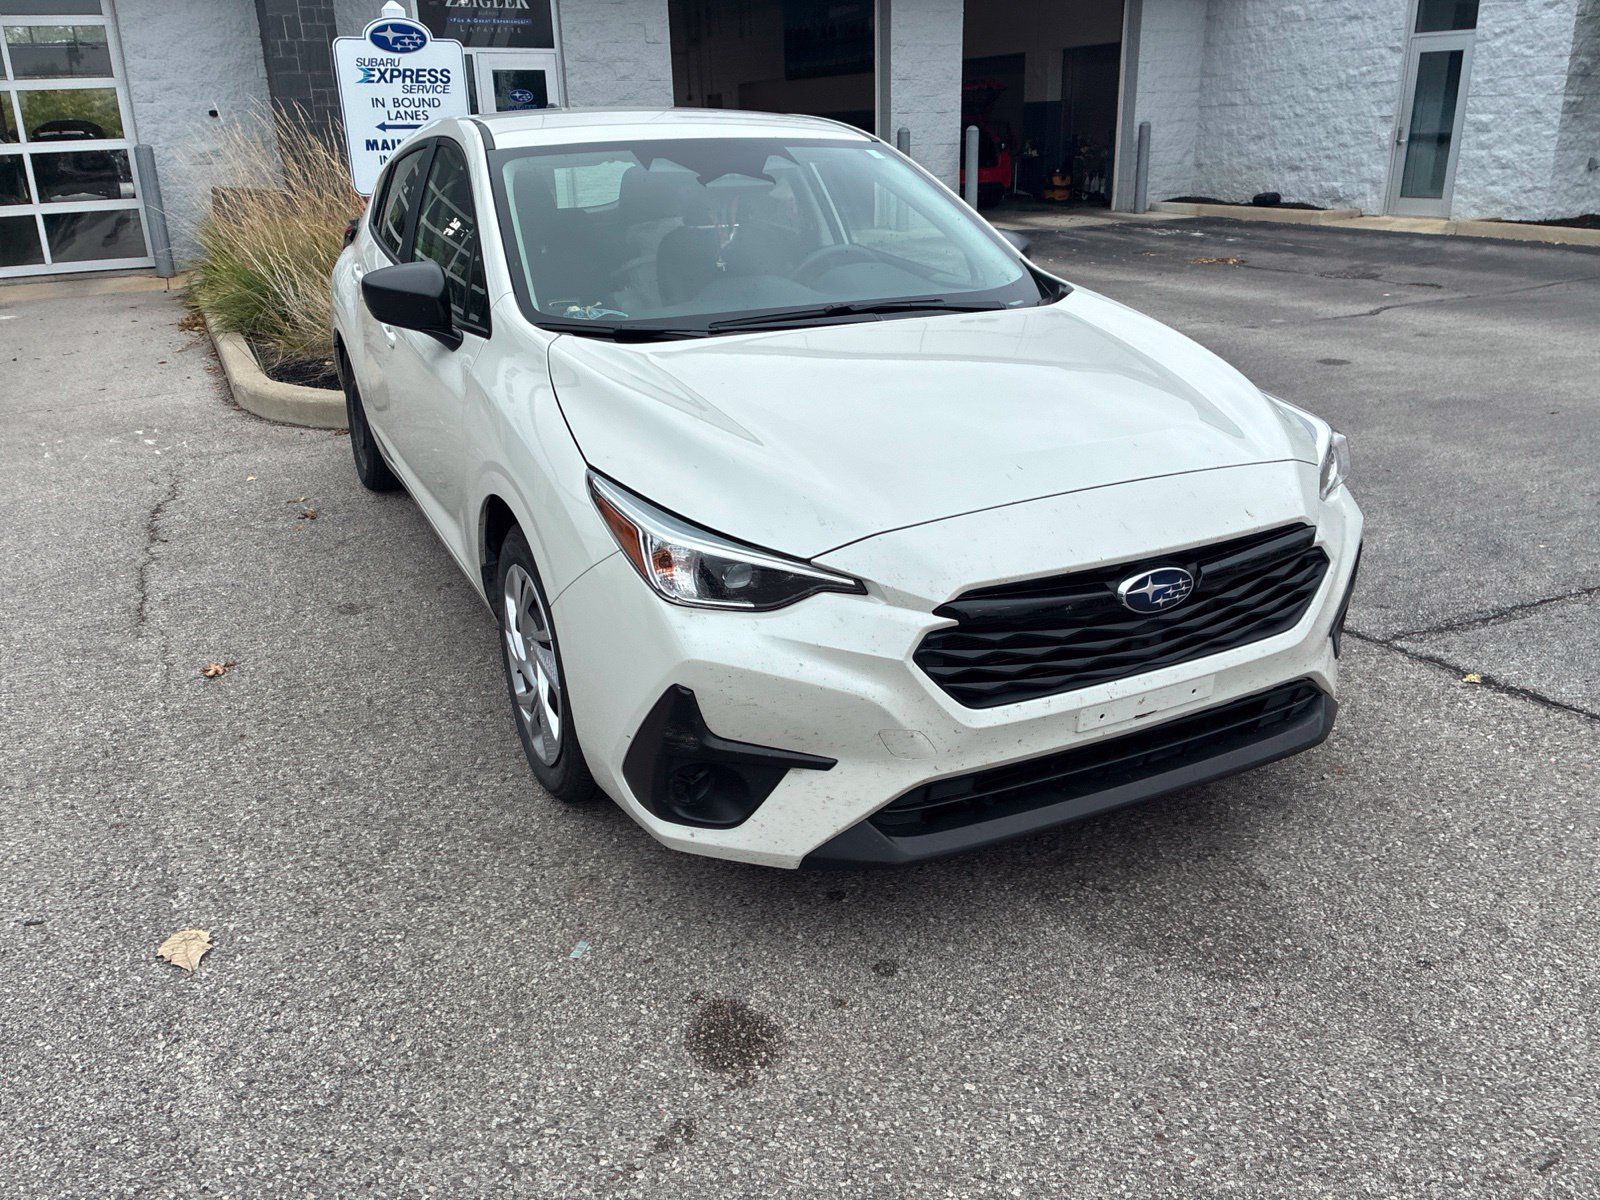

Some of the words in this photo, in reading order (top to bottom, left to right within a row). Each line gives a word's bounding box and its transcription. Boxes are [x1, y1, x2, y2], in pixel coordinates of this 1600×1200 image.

[356, 57, 401, 67] SUBARU
[356, 67, 451, 84] EXPRESS
[402, 84, 450, 94] SERVICE
[371, 97, 386, 108] IN
[392, 97, 441, 108] BOUND
[387, 110, 430, 121] LANES
